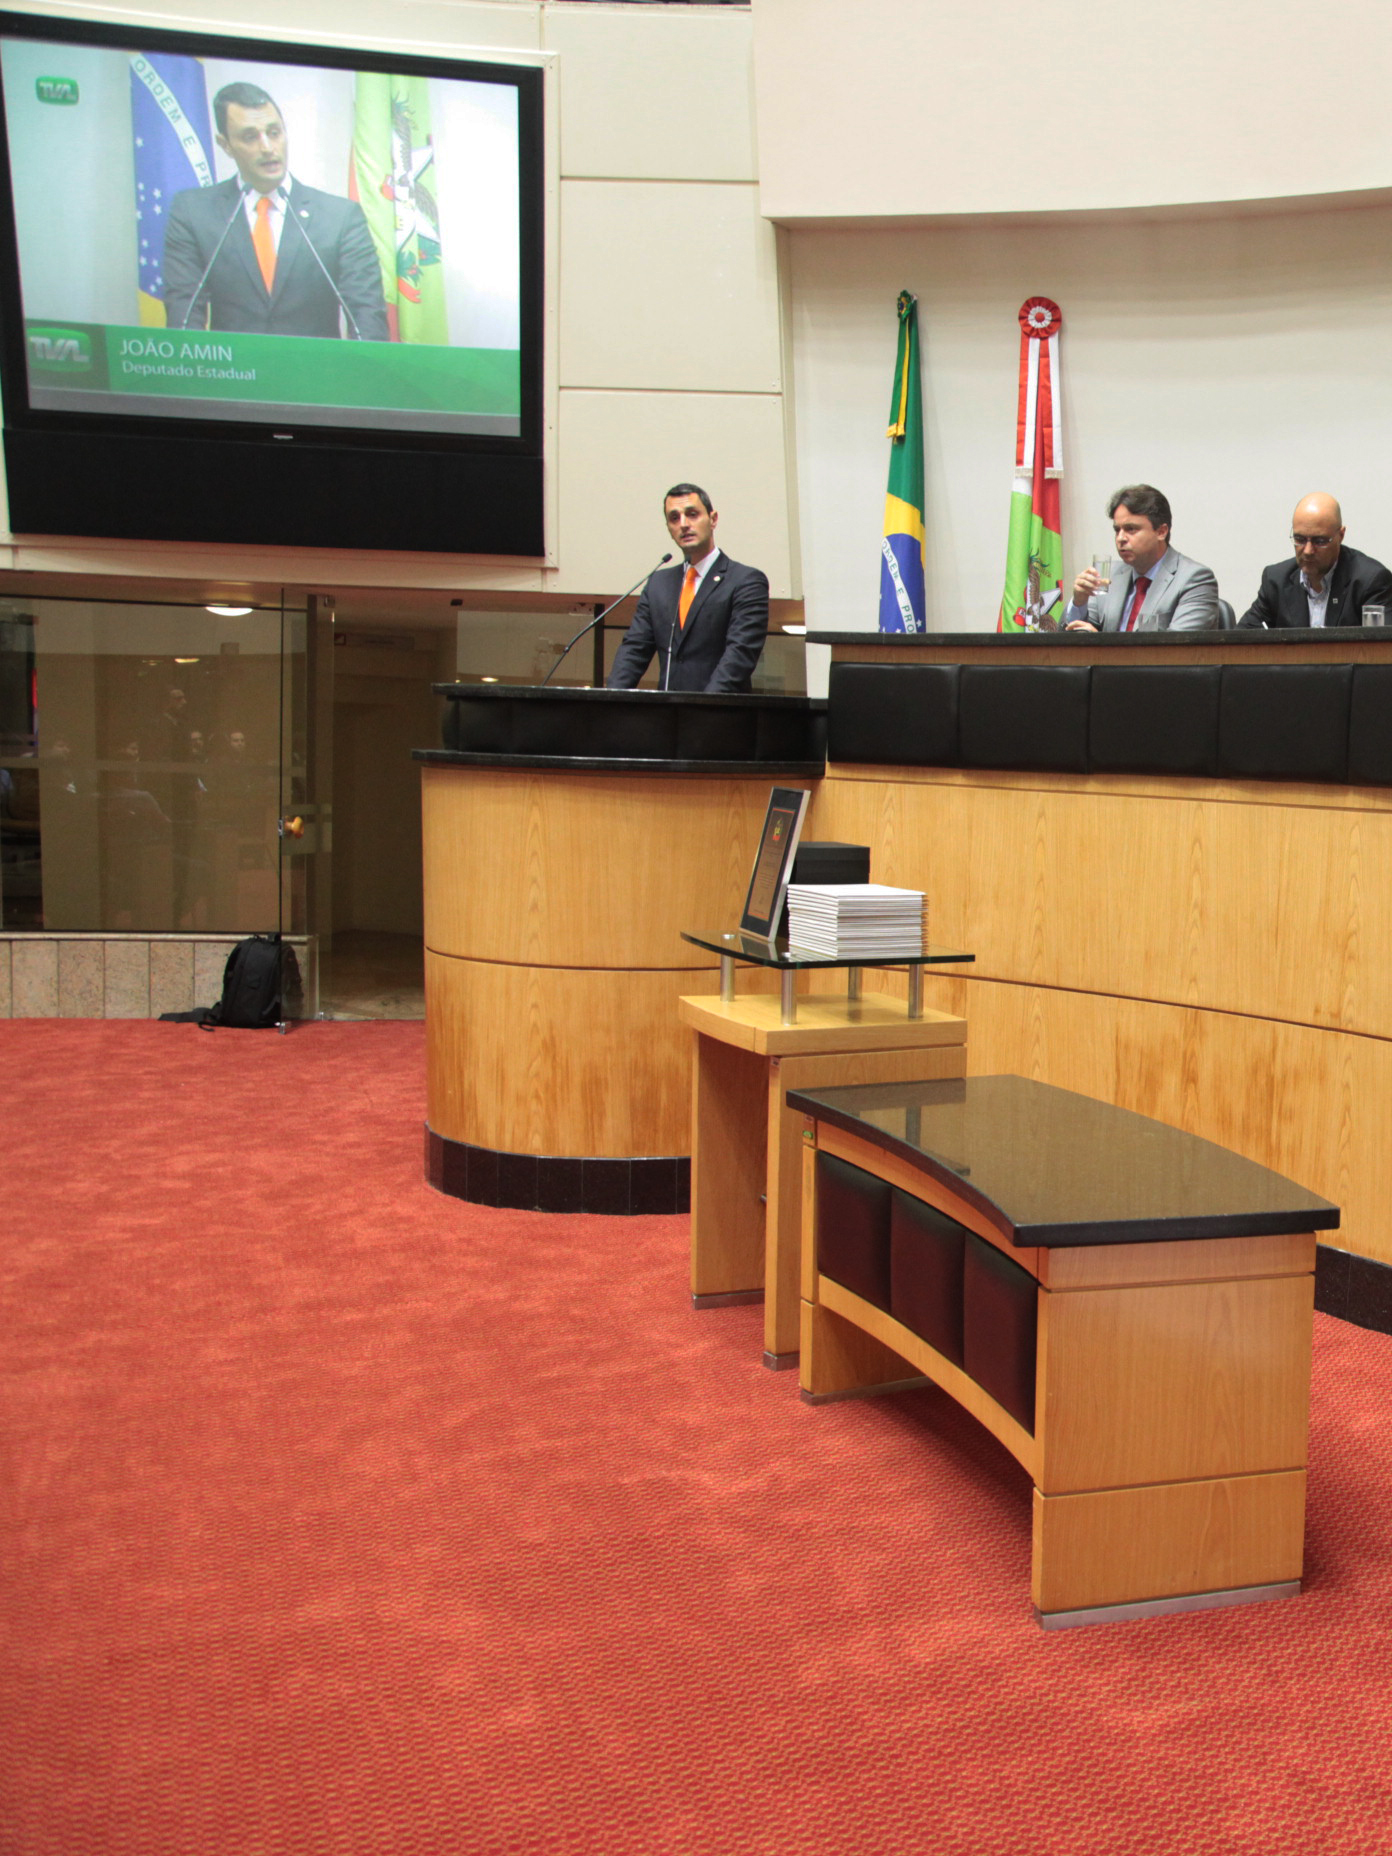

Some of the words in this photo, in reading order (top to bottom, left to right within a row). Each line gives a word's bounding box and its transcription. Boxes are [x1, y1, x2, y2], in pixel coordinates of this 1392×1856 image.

[135, 60, 181, 123] ORDEM
[120, 338, 174, 358] JOÃO
[180, 343, 233, 361] AMIN
[122, 360, 194, 377] Deputado
[197, 365, 257, 380] Estadual
